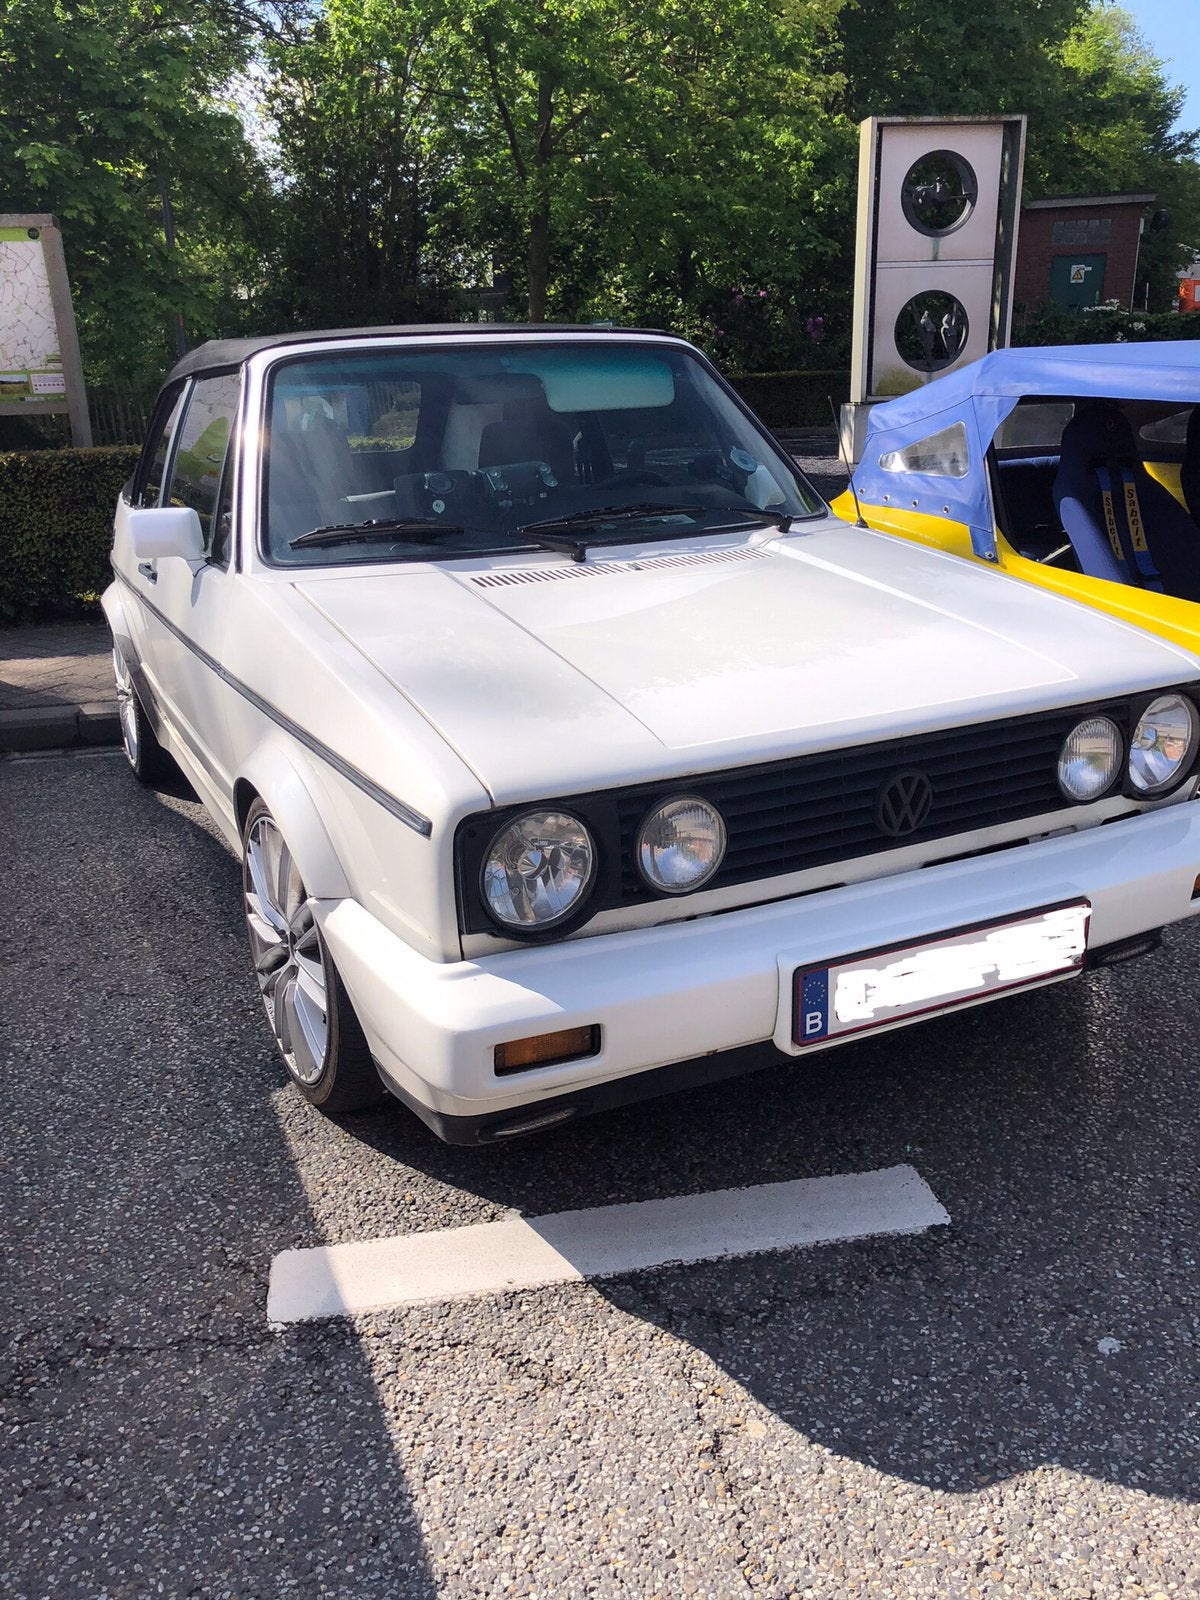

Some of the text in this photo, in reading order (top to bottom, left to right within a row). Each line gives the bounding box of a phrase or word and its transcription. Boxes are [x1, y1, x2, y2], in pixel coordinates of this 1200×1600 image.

[1104, 497, 1120, 555] Sabelt
[1126, 488, 1142, 547] Sabelt
[880, 771, 932, 836] VW
[805, 1011, 823, 1035] B
